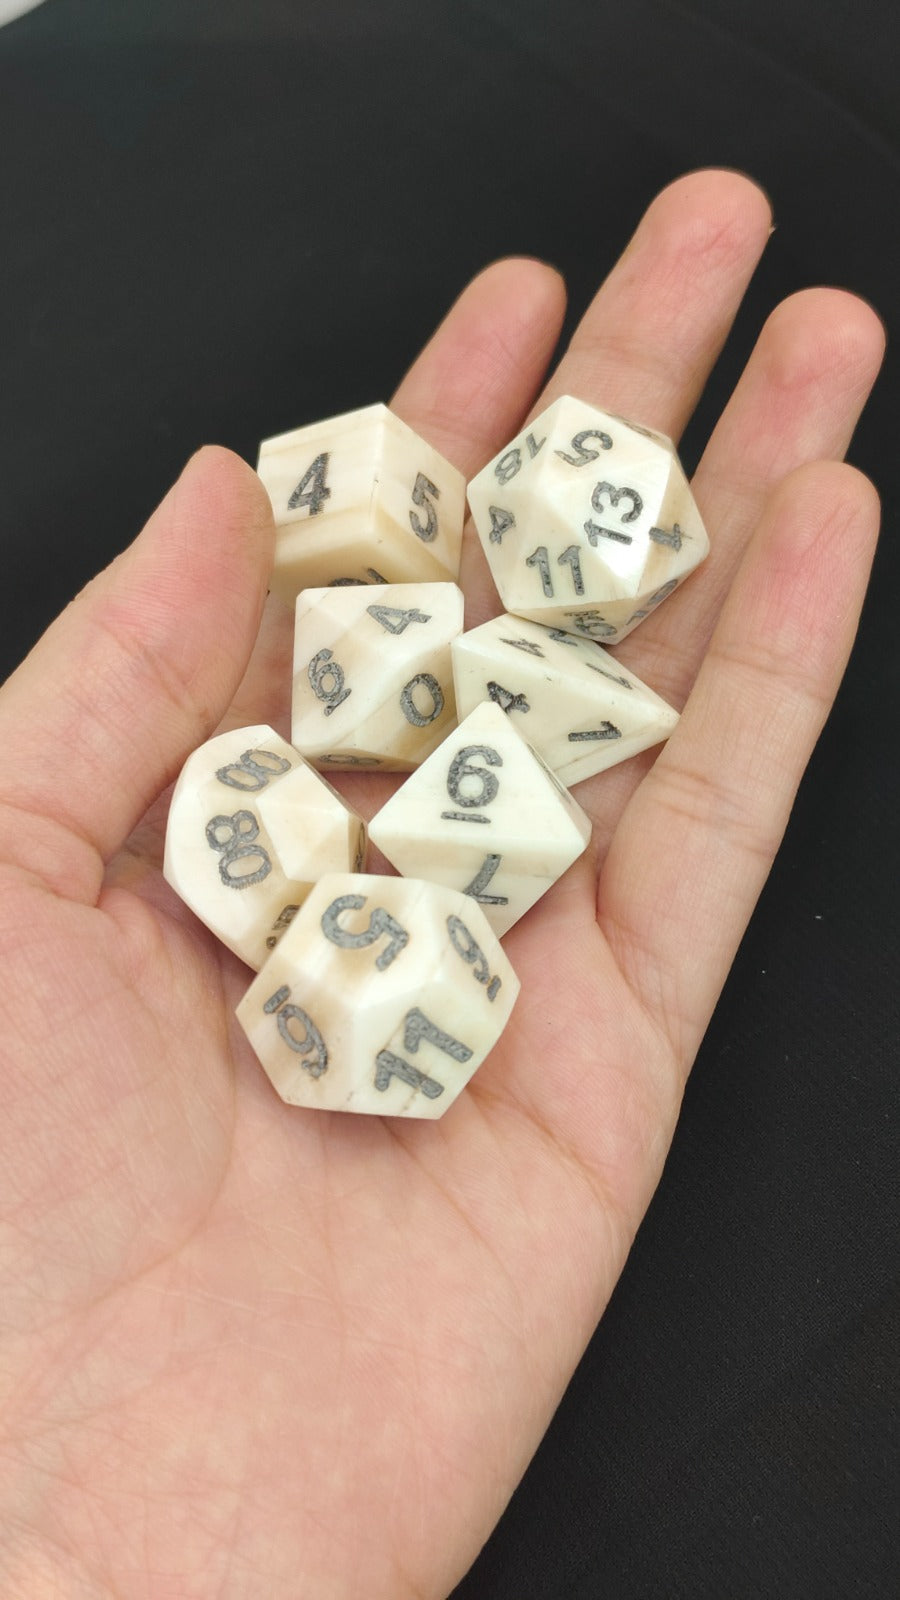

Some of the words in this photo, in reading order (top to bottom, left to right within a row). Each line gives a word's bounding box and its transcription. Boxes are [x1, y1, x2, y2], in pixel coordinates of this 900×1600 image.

[494, 433, 547, 486] 18
[554, 430, 613, 468] 5
[287, 452, 331, 516] 4
[409, 471, 441, 543] 5
[489, 505, 516, 544] 4
[583, 481, 644, 548] 13
[526, 545, 585, 599] 11
[366, 604, 432, 635] 4
[308, 648, 352, 717] 6
[400, 673, 445, 728] 0
[568, 720, 622, 742] 1
[441, 744, 503, 824] 6
[321, 893, 410, 972] 5
[374, 1006, 474, 1100] 11
